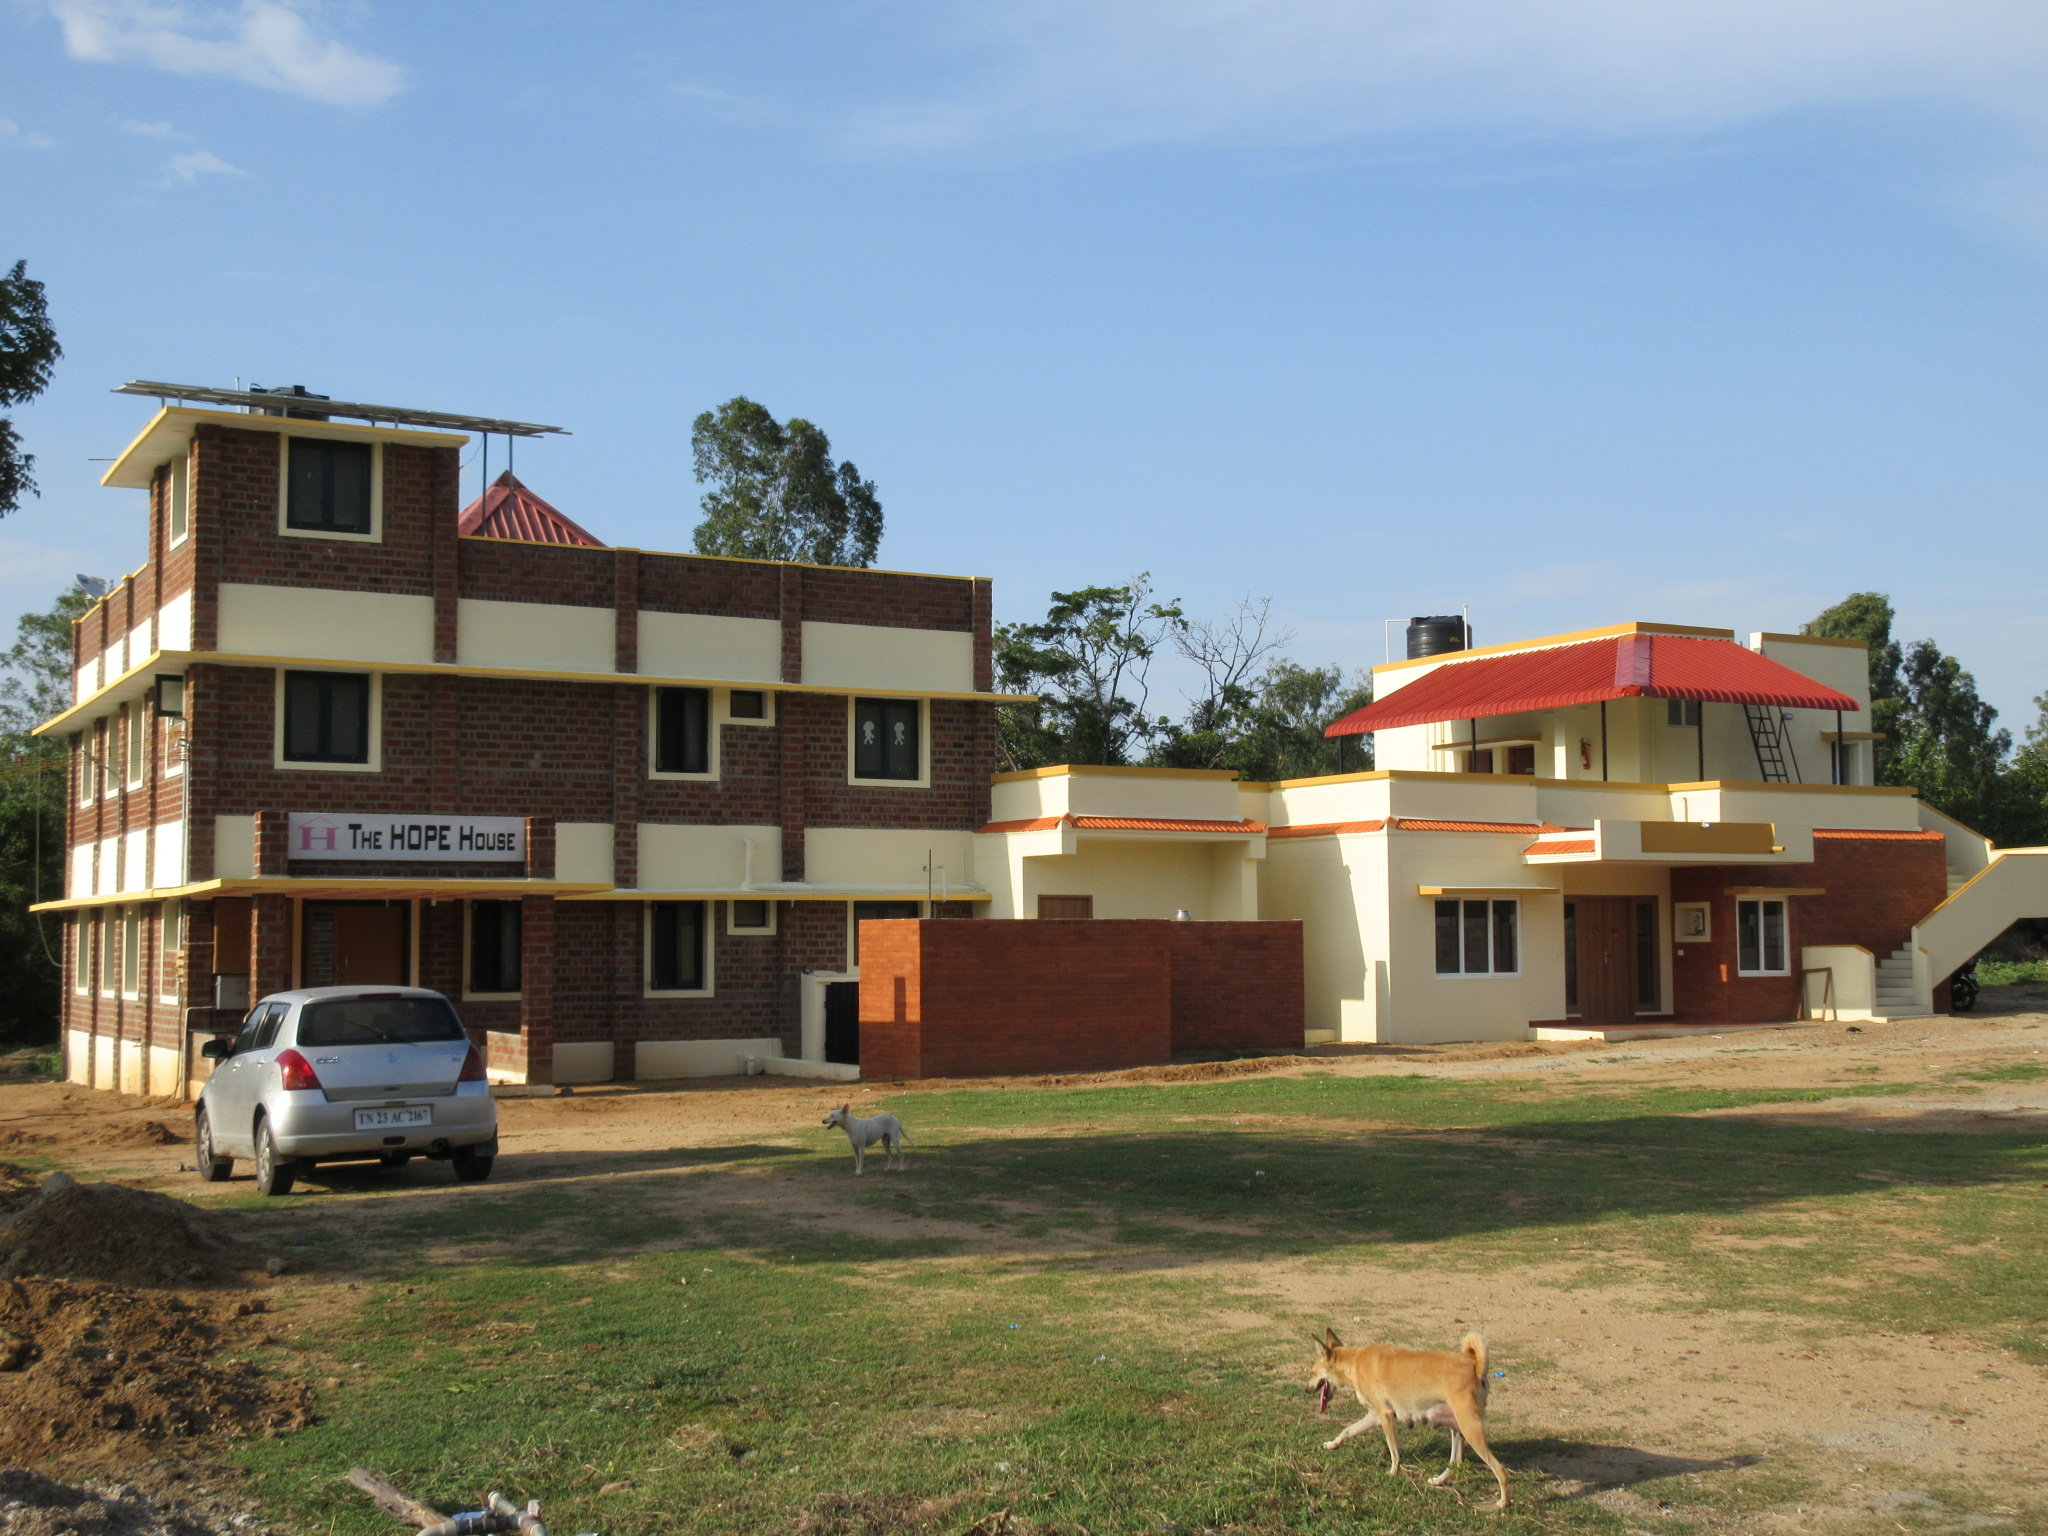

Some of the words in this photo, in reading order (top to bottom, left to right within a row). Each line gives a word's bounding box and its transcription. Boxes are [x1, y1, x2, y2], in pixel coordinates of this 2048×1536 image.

[390, 824, 451, 851] HOPE
[358, 1113, 374, 1125] TN
[377, 1111, 388, 1124] 23
[391, 1111, 405, 1123] AC
[407, 1109, 428, 1122] 2167
